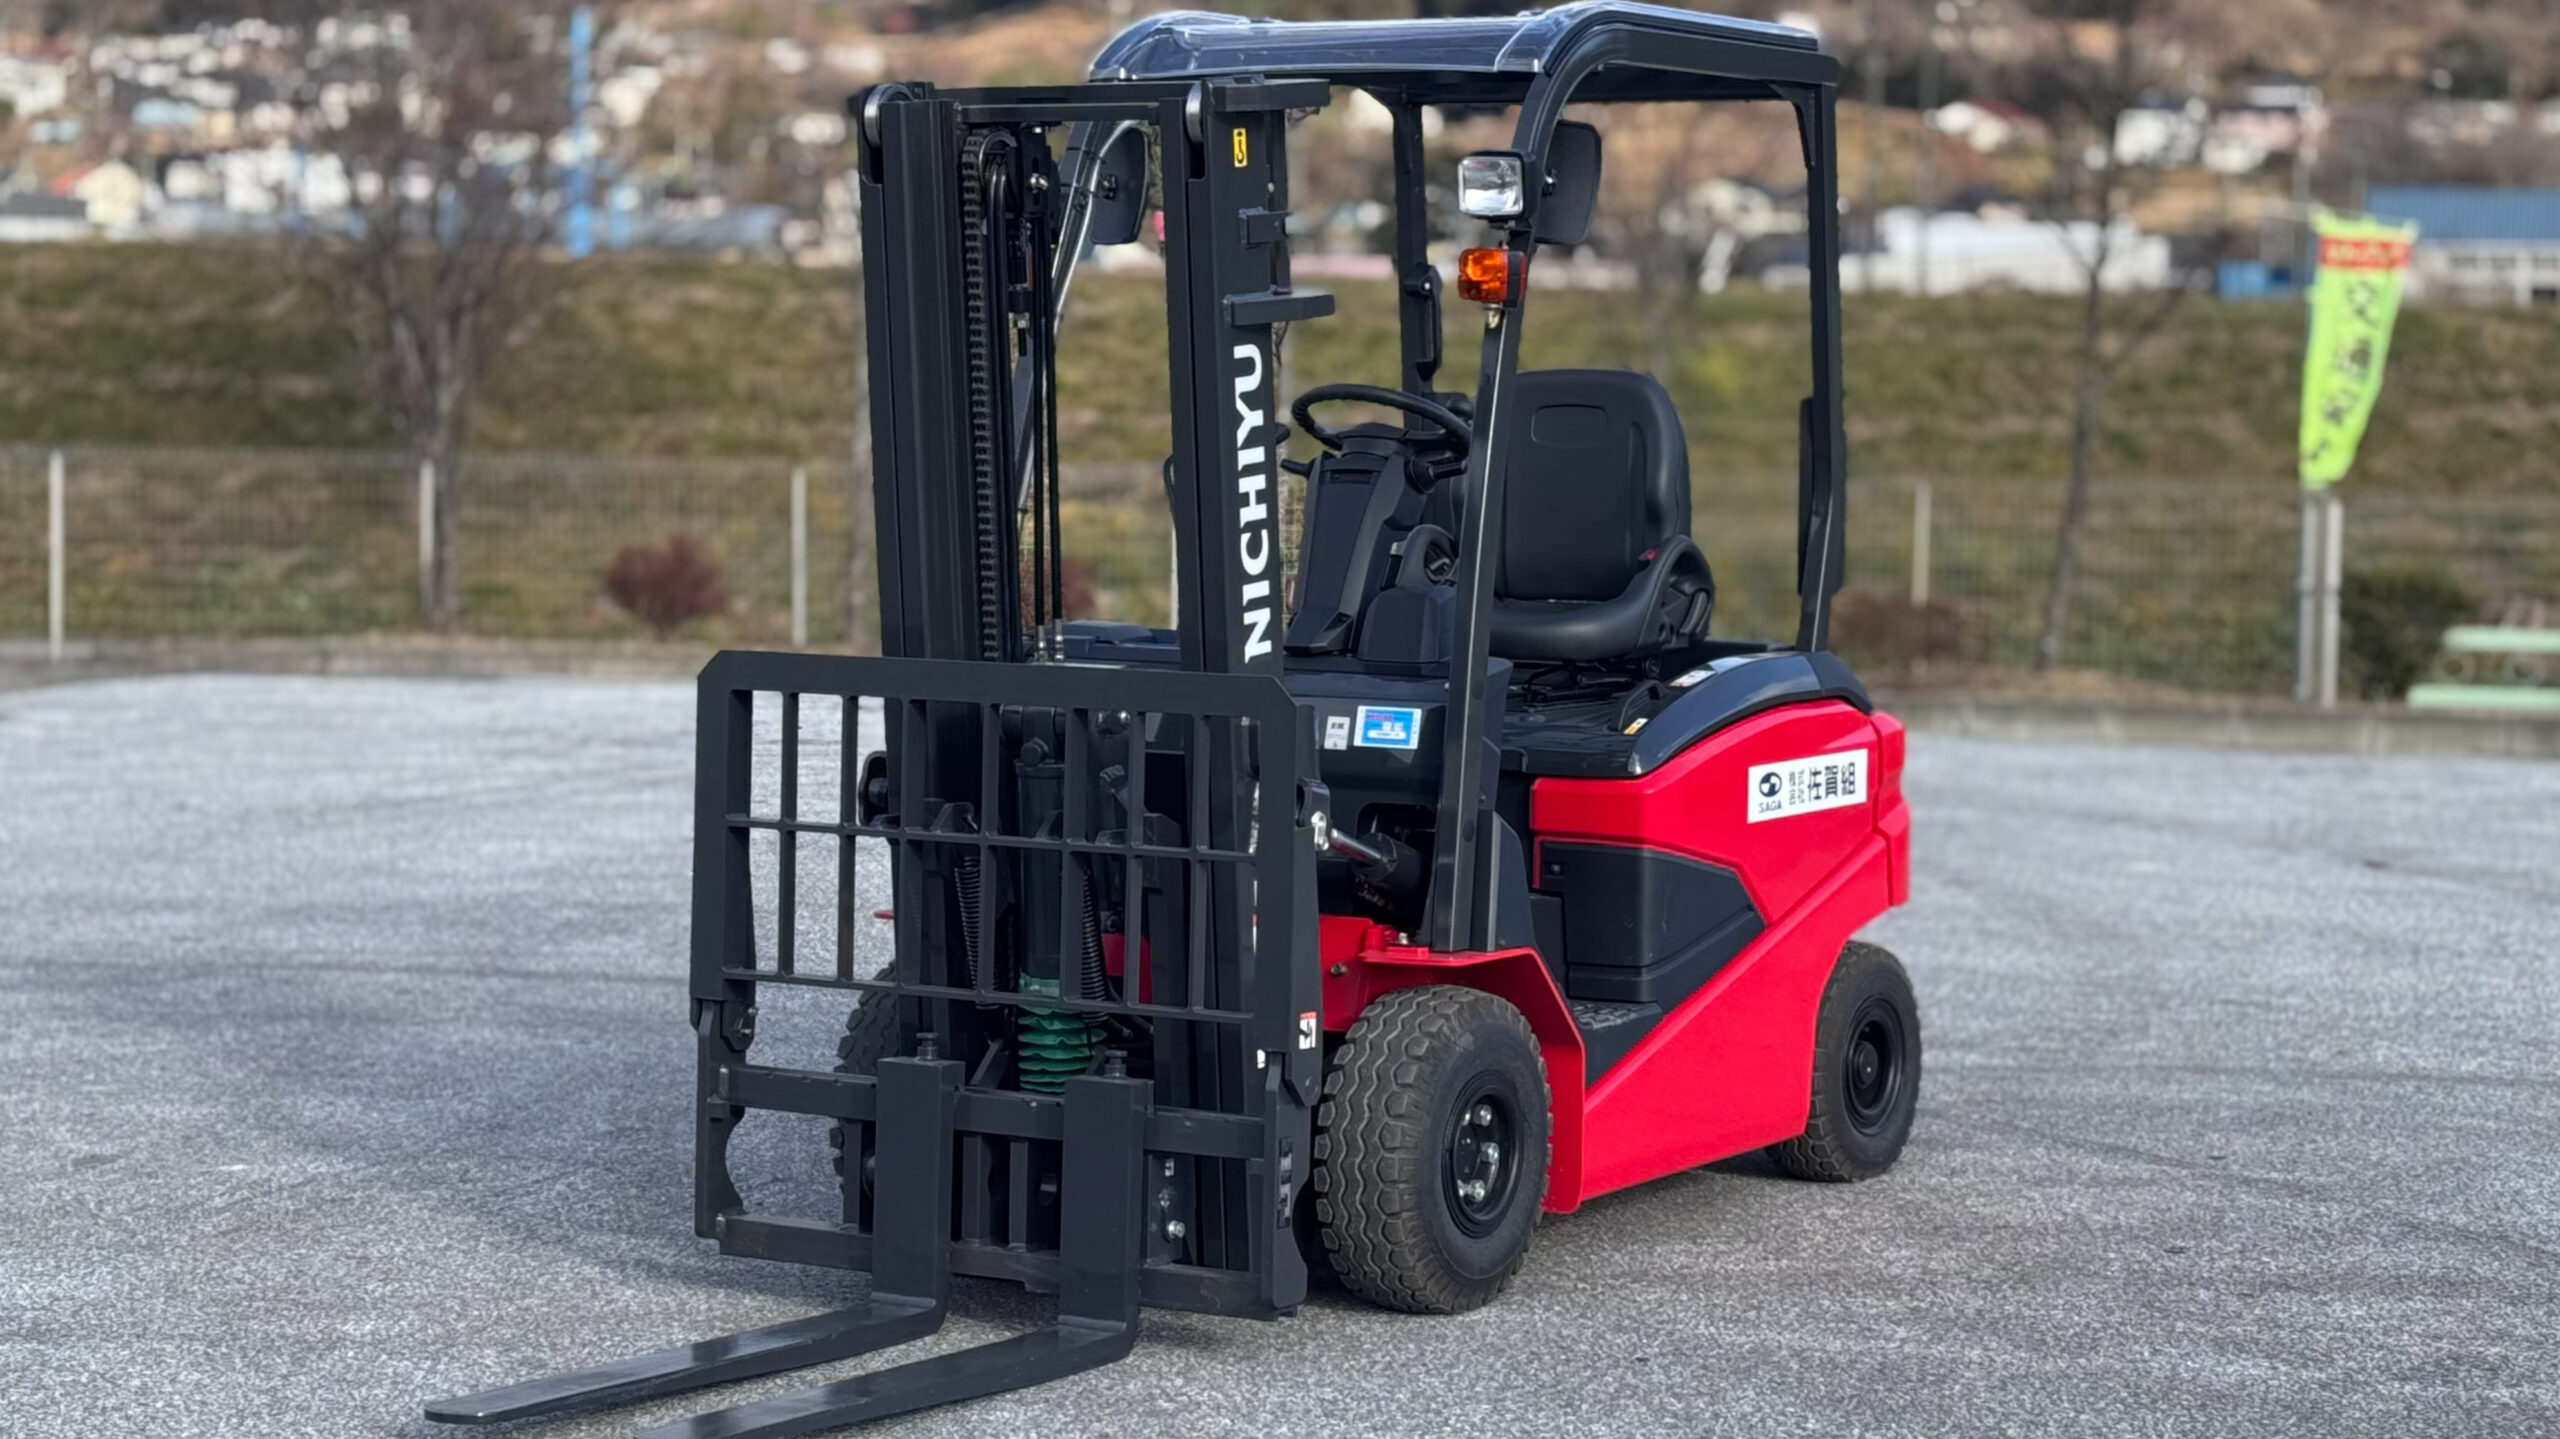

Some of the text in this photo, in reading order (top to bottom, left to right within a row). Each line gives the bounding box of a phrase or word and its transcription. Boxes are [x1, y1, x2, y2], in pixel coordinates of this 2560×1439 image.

[1233, 343, 1272, 664] NICHIYU
[1807, 762, 1856, 802] 佐賀組
[1759, 800, 1782, 814] SAGA
